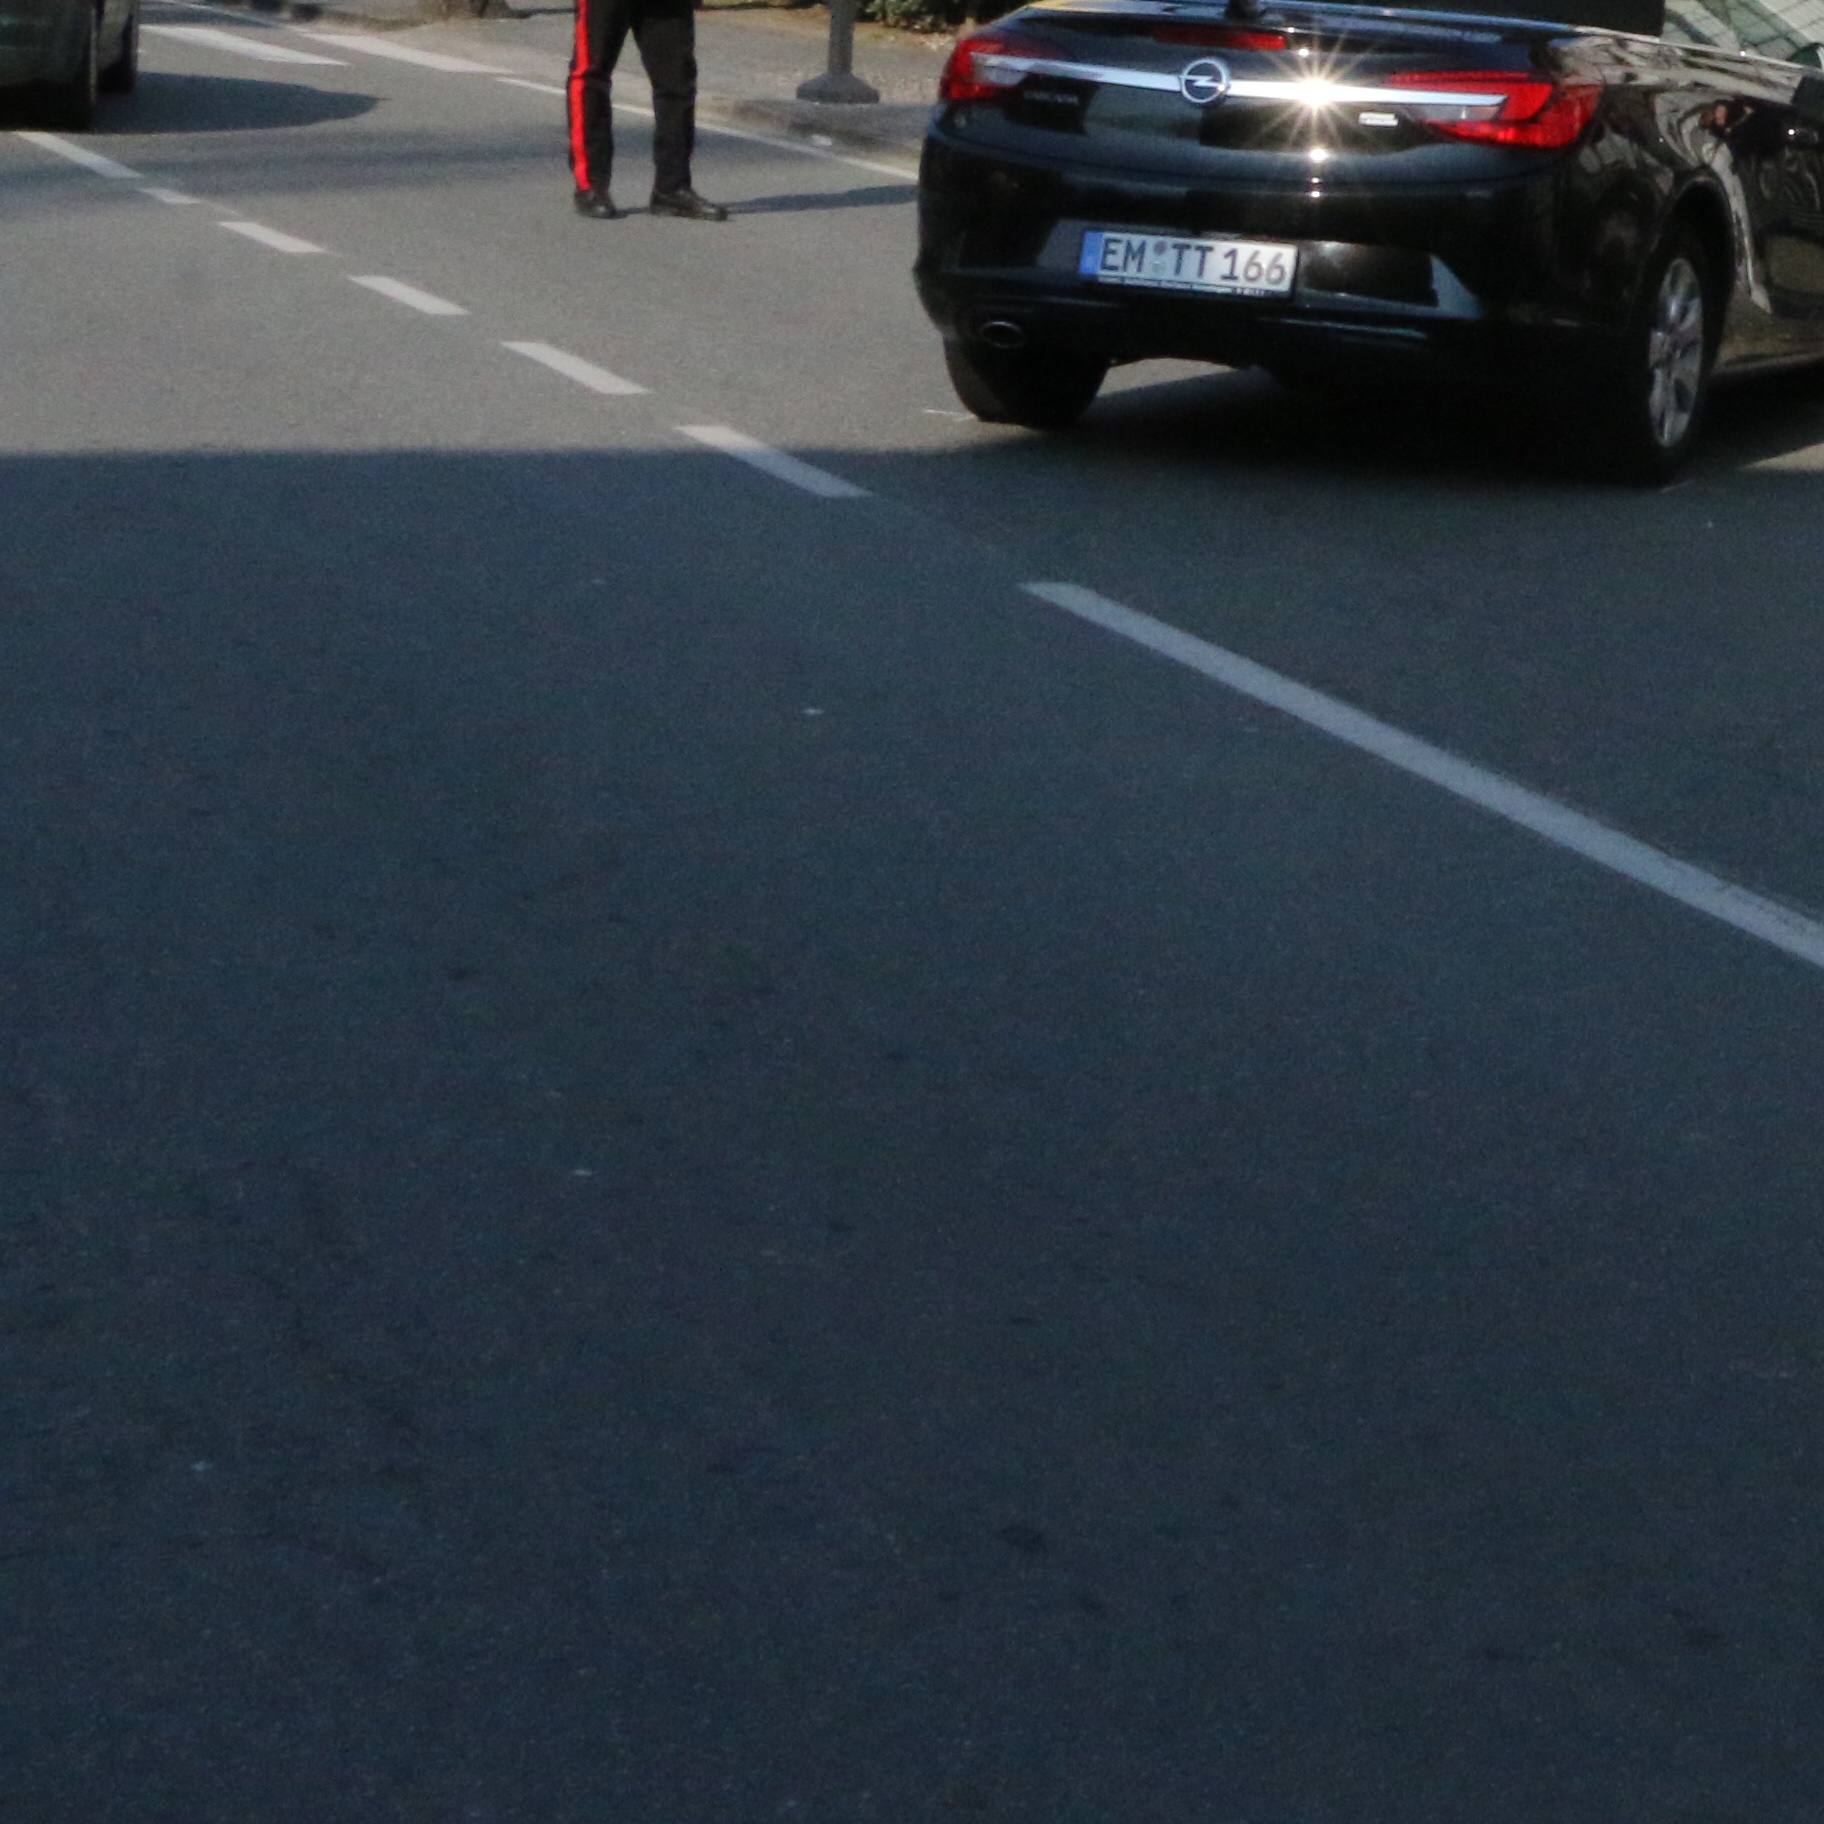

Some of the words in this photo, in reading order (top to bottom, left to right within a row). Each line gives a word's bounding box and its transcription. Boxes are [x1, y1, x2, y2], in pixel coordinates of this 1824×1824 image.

[1099, 237, 1146, 274] EM
[1171, 242, 1213, 280] TT
[1221, 248, 1288, 285] 166
